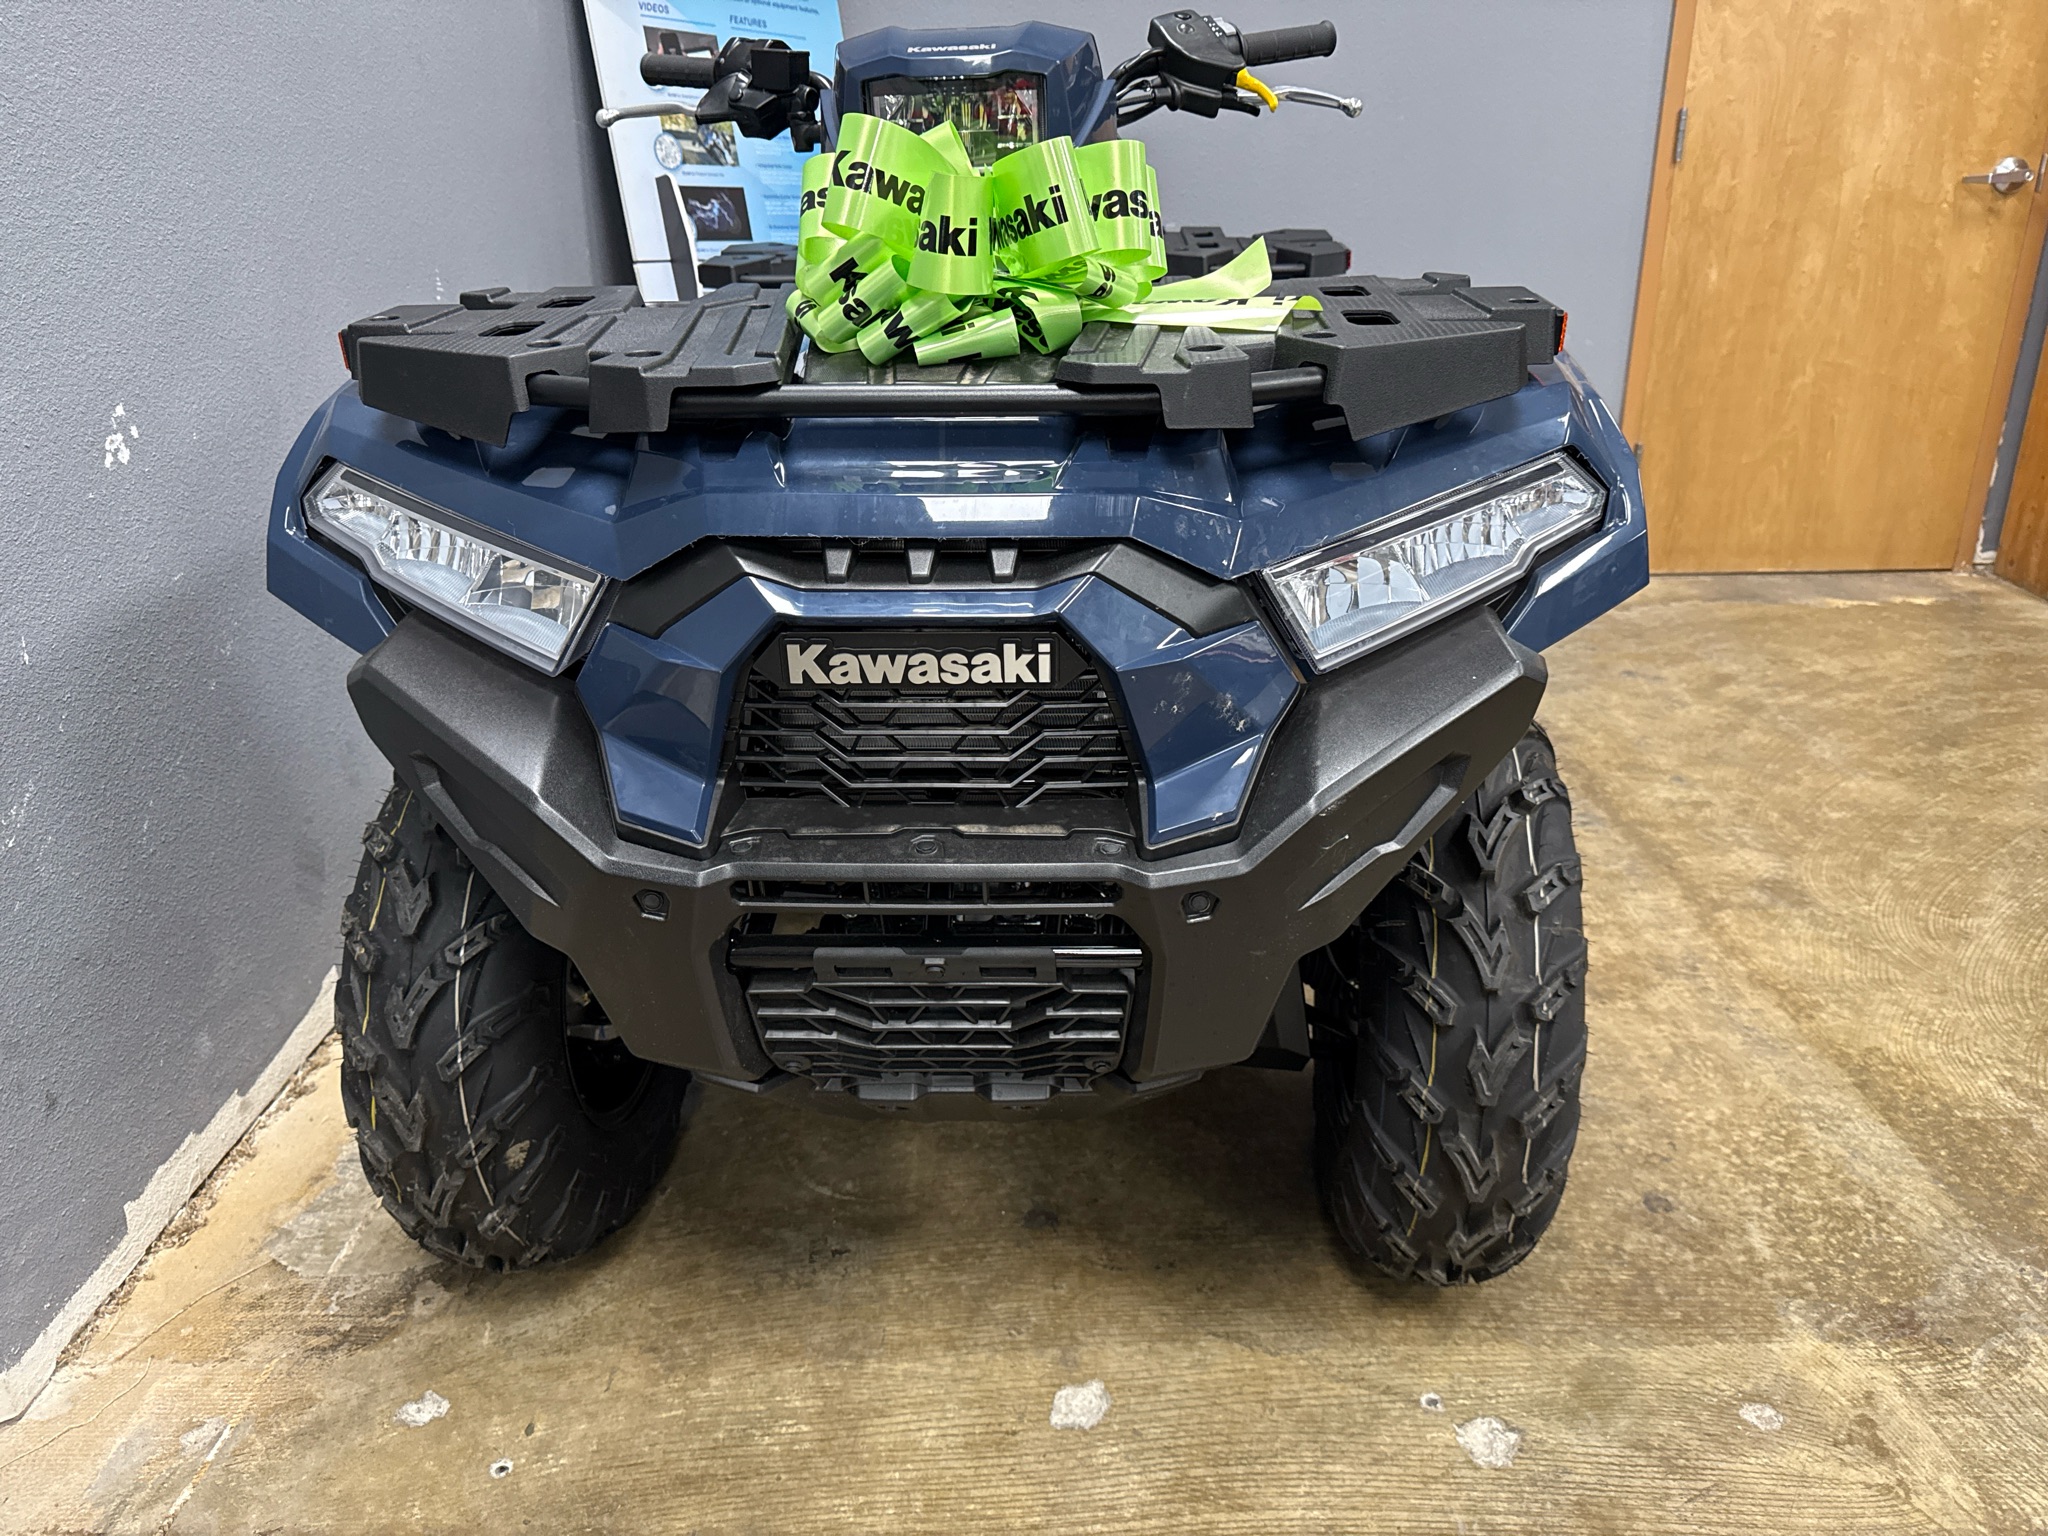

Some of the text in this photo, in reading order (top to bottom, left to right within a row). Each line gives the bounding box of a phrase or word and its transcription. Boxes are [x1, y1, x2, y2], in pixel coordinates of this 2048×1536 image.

[638, 1, 670, 15] VIDEOS
[729, 14, 767, 29] FEATURES
[907, 43, 997, 53] Kawasaki
[914, 214, 978, 257] aki
[786, 643, 1051, 685] Kawasaki
